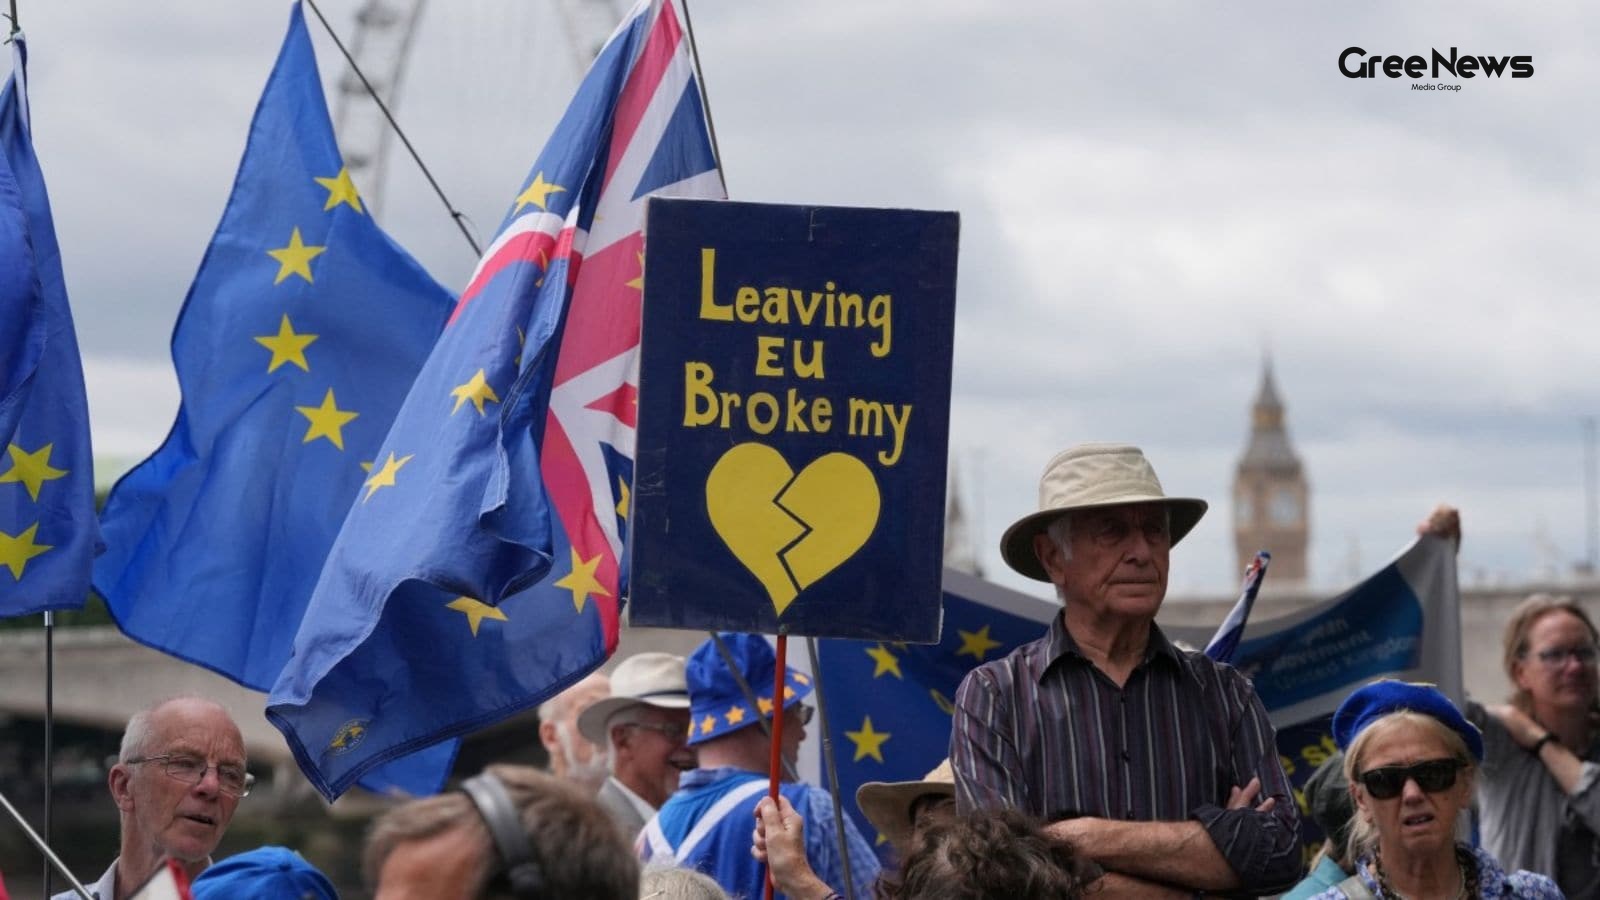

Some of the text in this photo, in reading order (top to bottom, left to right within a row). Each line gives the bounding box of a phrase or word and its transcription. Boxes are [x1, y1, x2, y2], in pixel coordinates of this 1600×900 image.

[700, 248, 892, 358] Leaving
[755, 336, 825, 379] EU
[683, 361, 912, 466] Broke my
